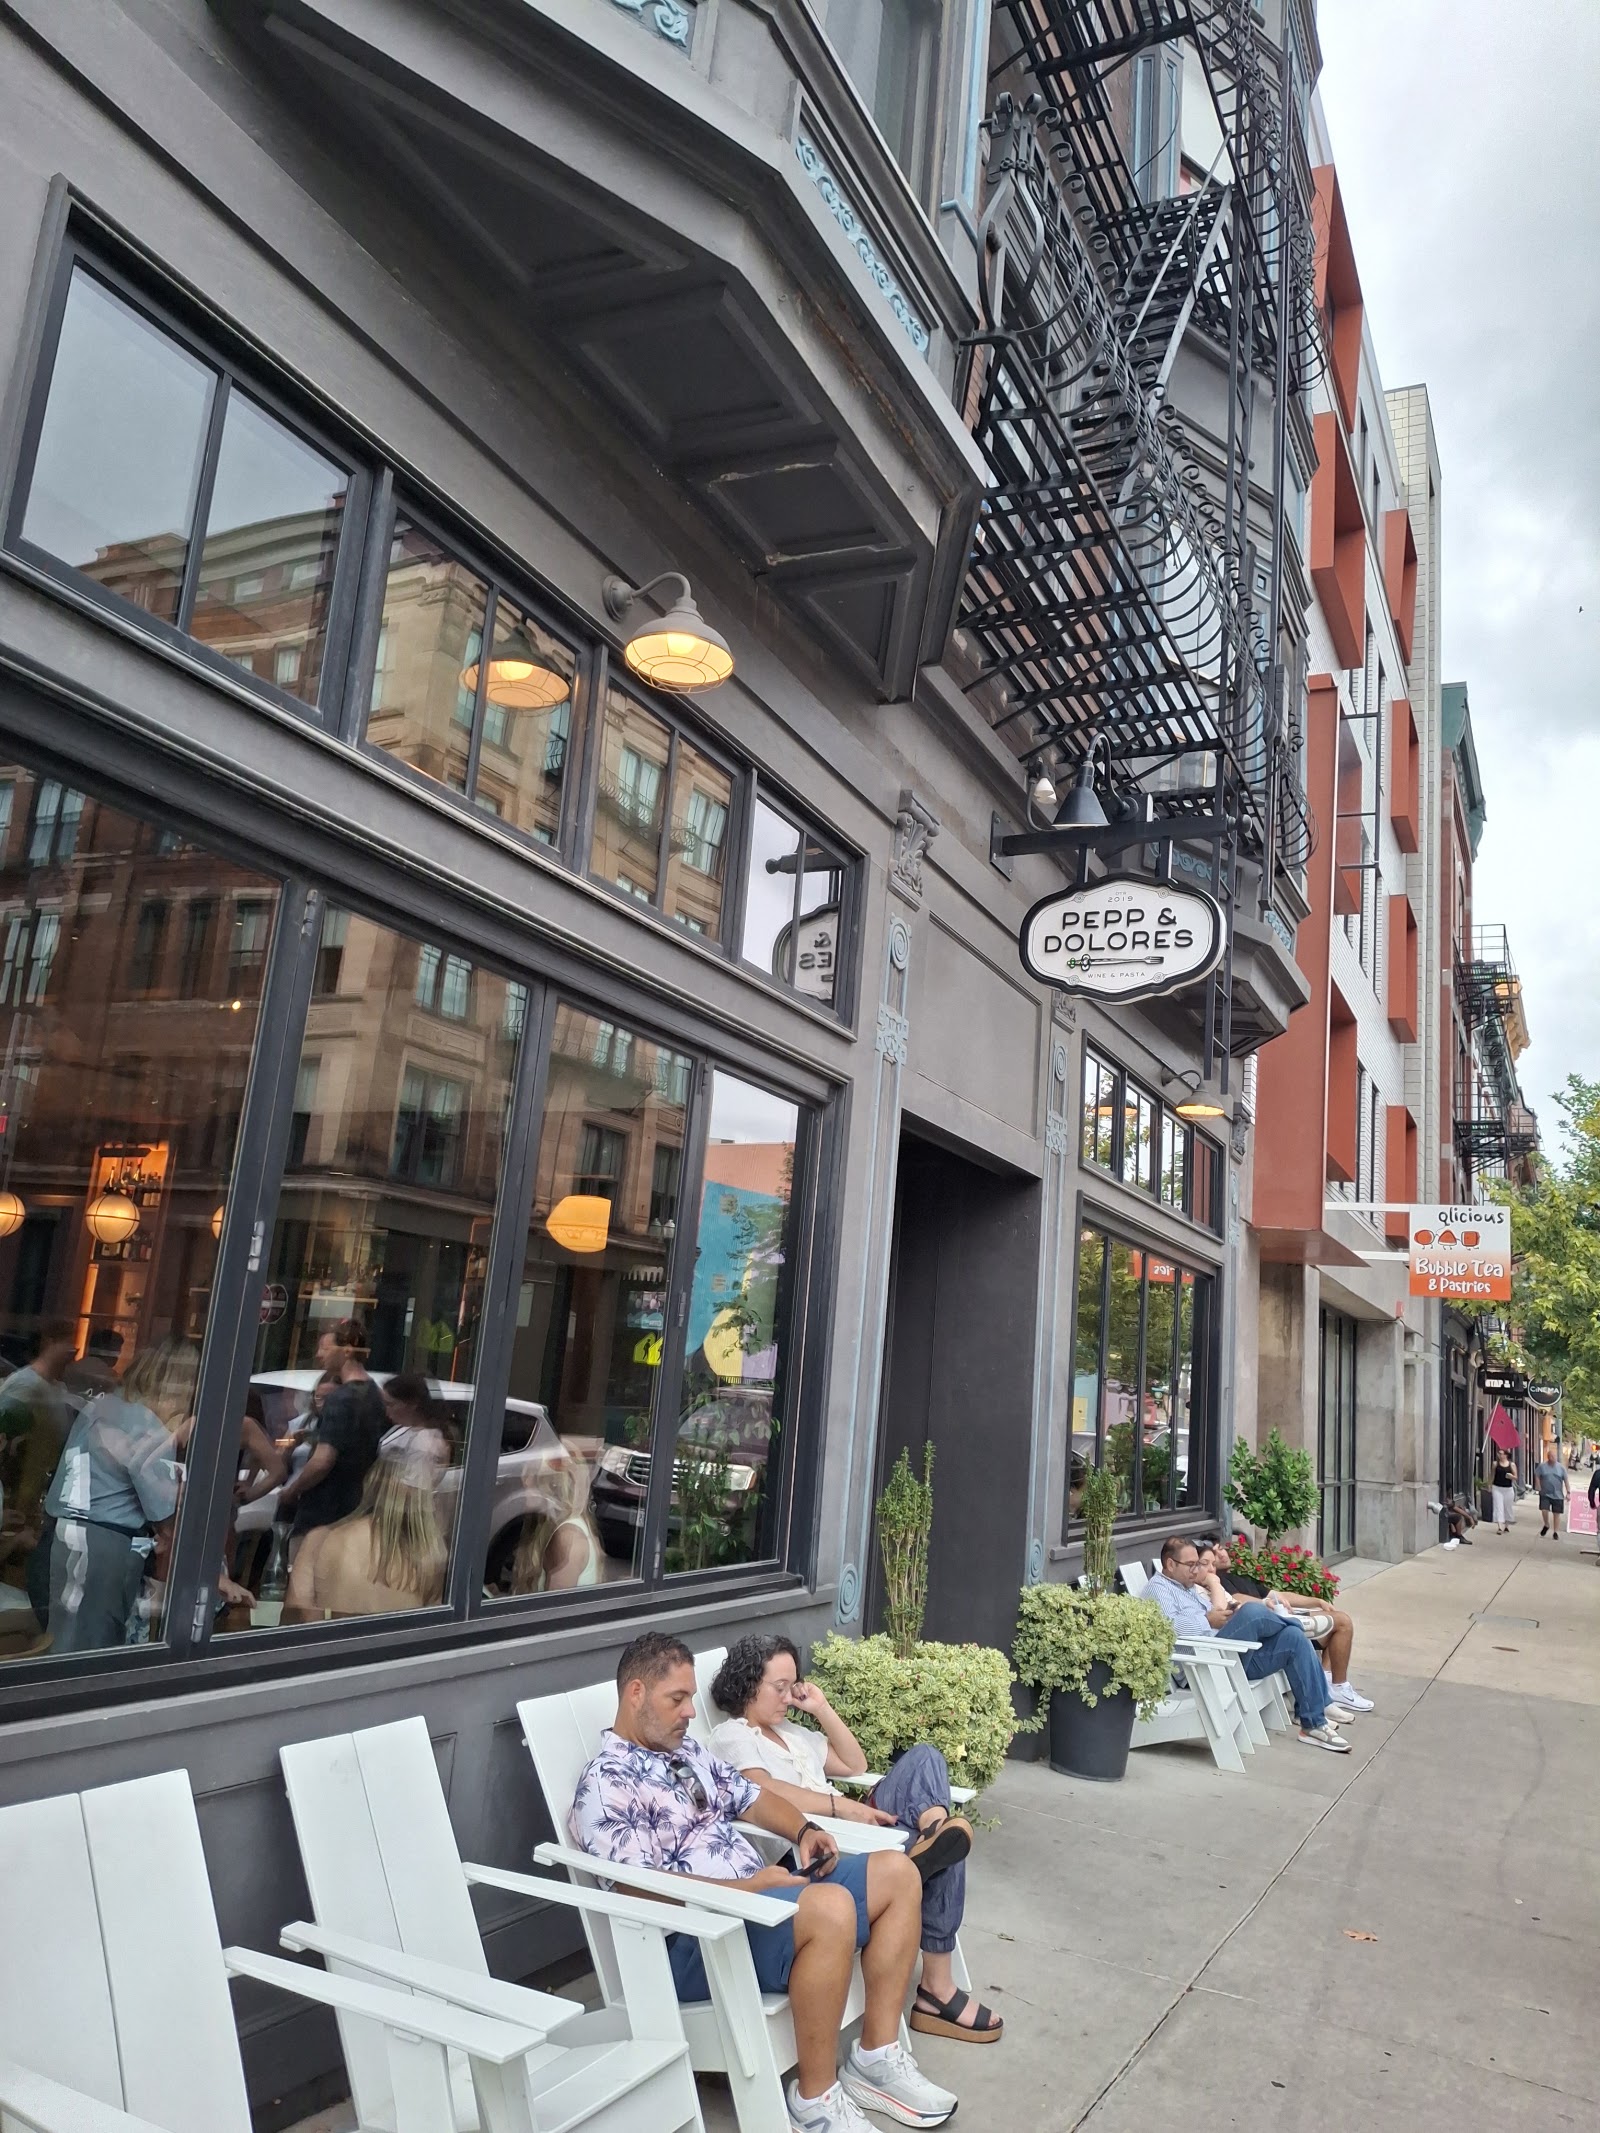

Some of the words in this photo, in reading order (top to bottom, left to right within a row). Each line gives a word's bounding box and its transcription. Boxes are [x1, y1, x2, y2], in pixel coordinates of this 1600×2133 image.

[1062, 908, 1145, 931] PEPP
[1157, 907, 1177, 926] &
[1044, 929, 1194, 954] DOLORES
[1415, 1257, 1468, 1276] Bubble
[1471, 1259, 1504, 1278] Tea
[1428, 1277, 1437, 1291] &
[1440, 1277, 1491, 1294] Pastries
